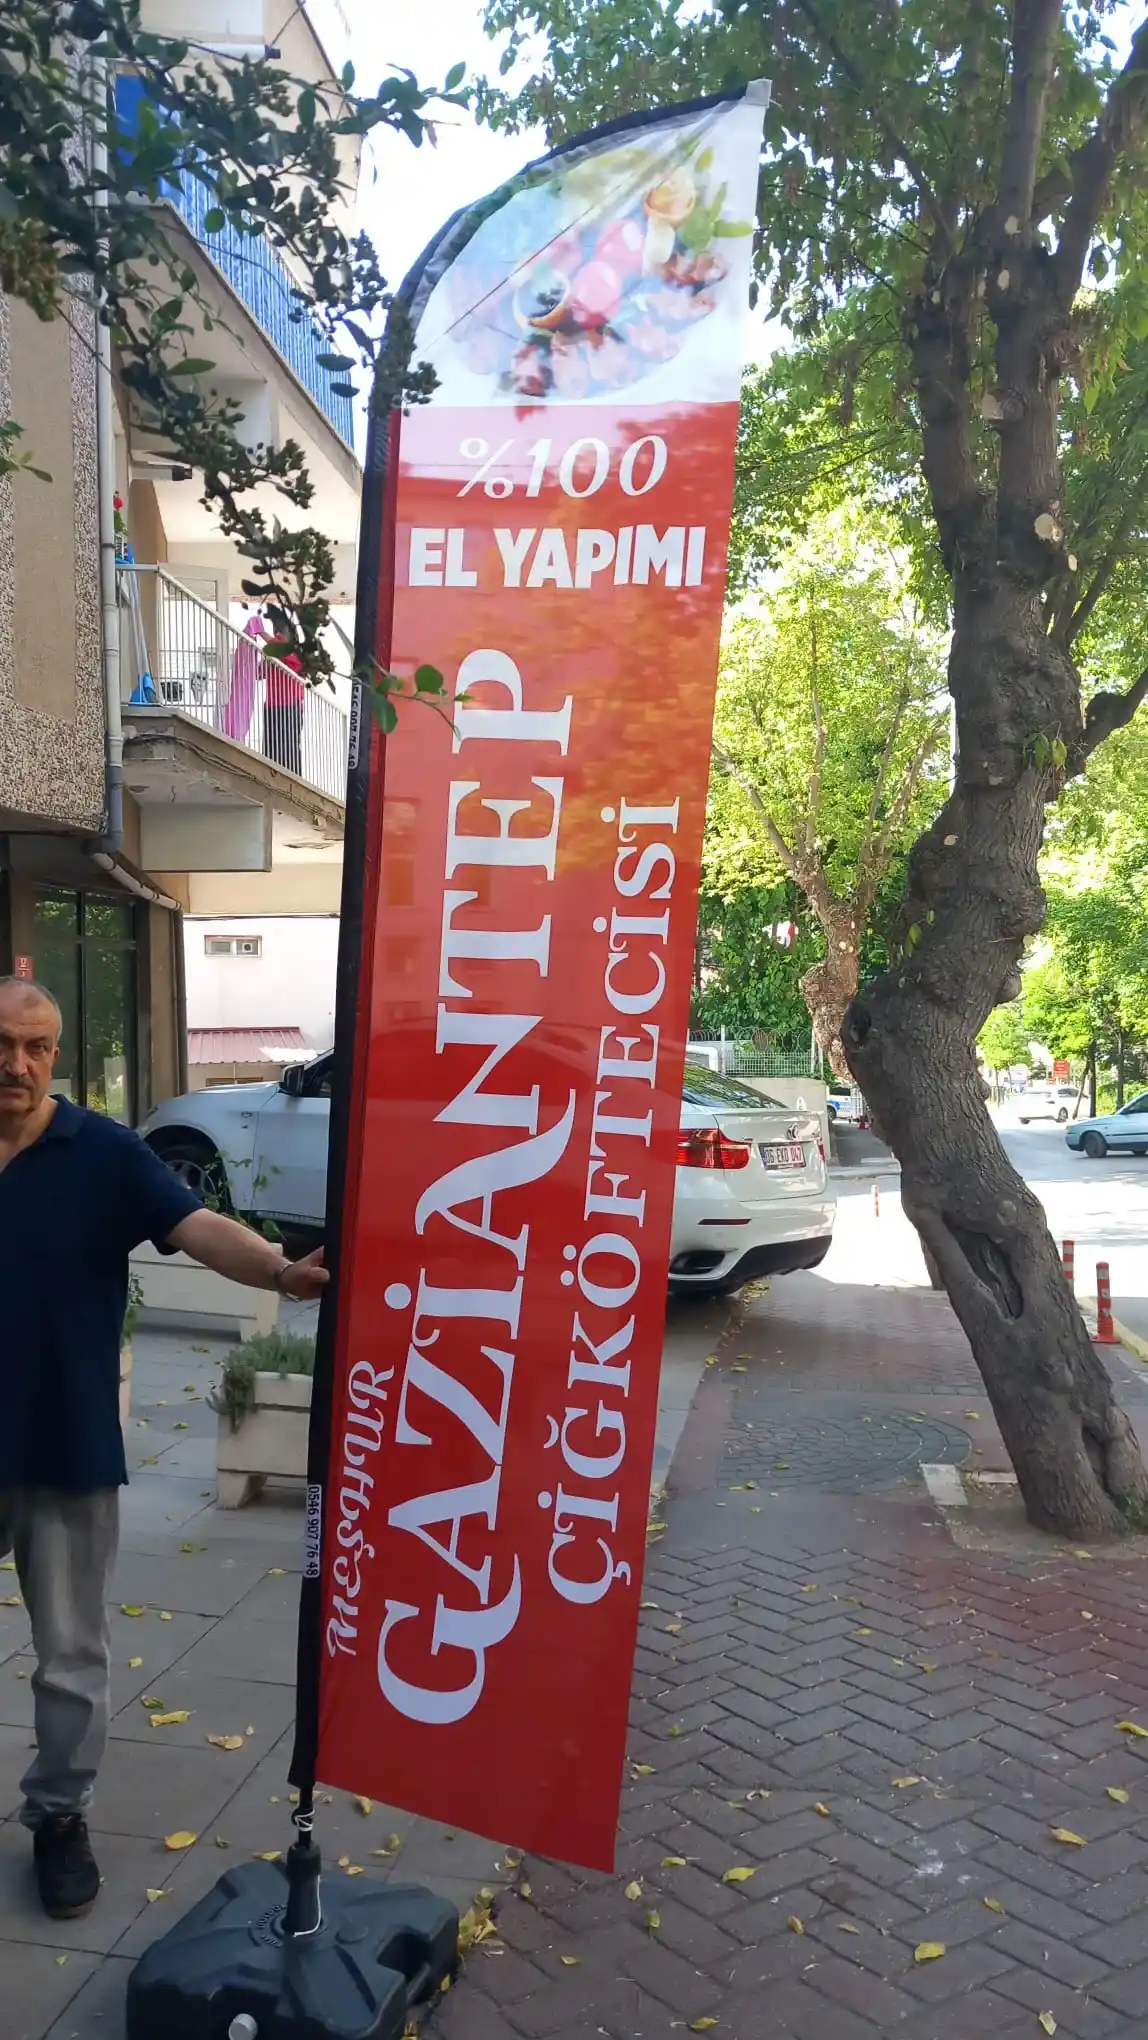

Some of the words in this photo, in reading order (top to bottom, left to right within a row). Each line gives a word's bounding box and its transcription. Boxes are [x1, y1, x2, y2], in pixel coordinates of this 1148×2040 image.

[455, 434, 668, 499] %100
[408, 526, 478, 587] EL
[493, 524, 706, 589] YAPIMI
[377, 648, 576, 1725] GAZİANTEP
[537, 796, 681, 1605] ÇİĞKÖFTECİSİ
[307, 1518, 319, 1540] 907
[308, 1486, 320, 1515] 0546
[326, 1360, 395, 1656] MEŞHUR
[306, 1544, 319, 1558] 76
[306, 1561, 319, 1576] 48
